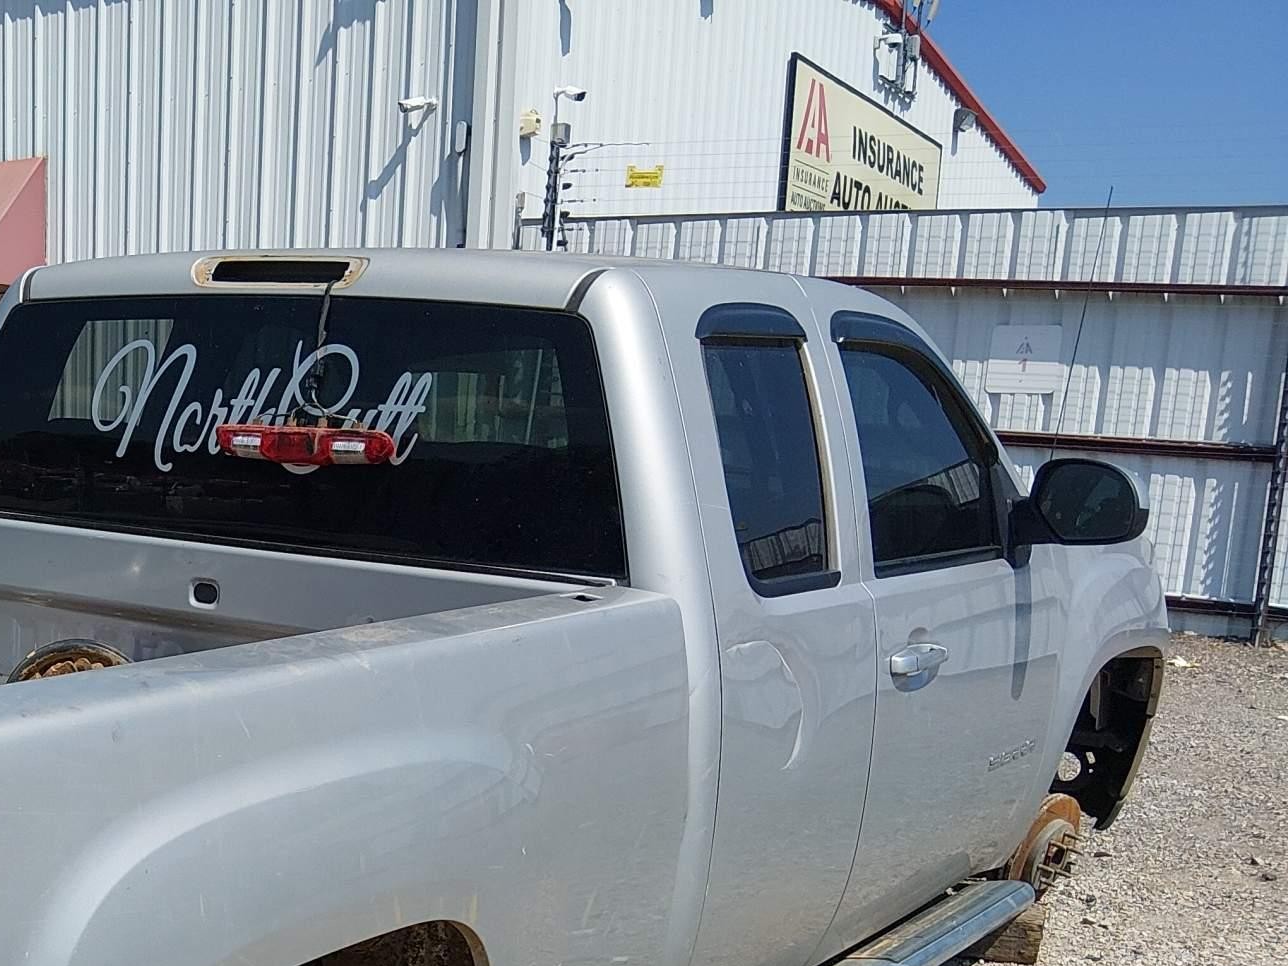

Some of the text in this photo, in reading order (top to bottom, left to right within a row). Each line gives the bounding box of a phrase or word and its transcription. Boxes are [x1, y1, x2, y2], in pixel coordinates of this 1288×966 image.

[792, 166, 829, 193] INSURANCE
[852, 126, 924, 196] INSURANCE
[830, 171, 871, 210] AUTO
